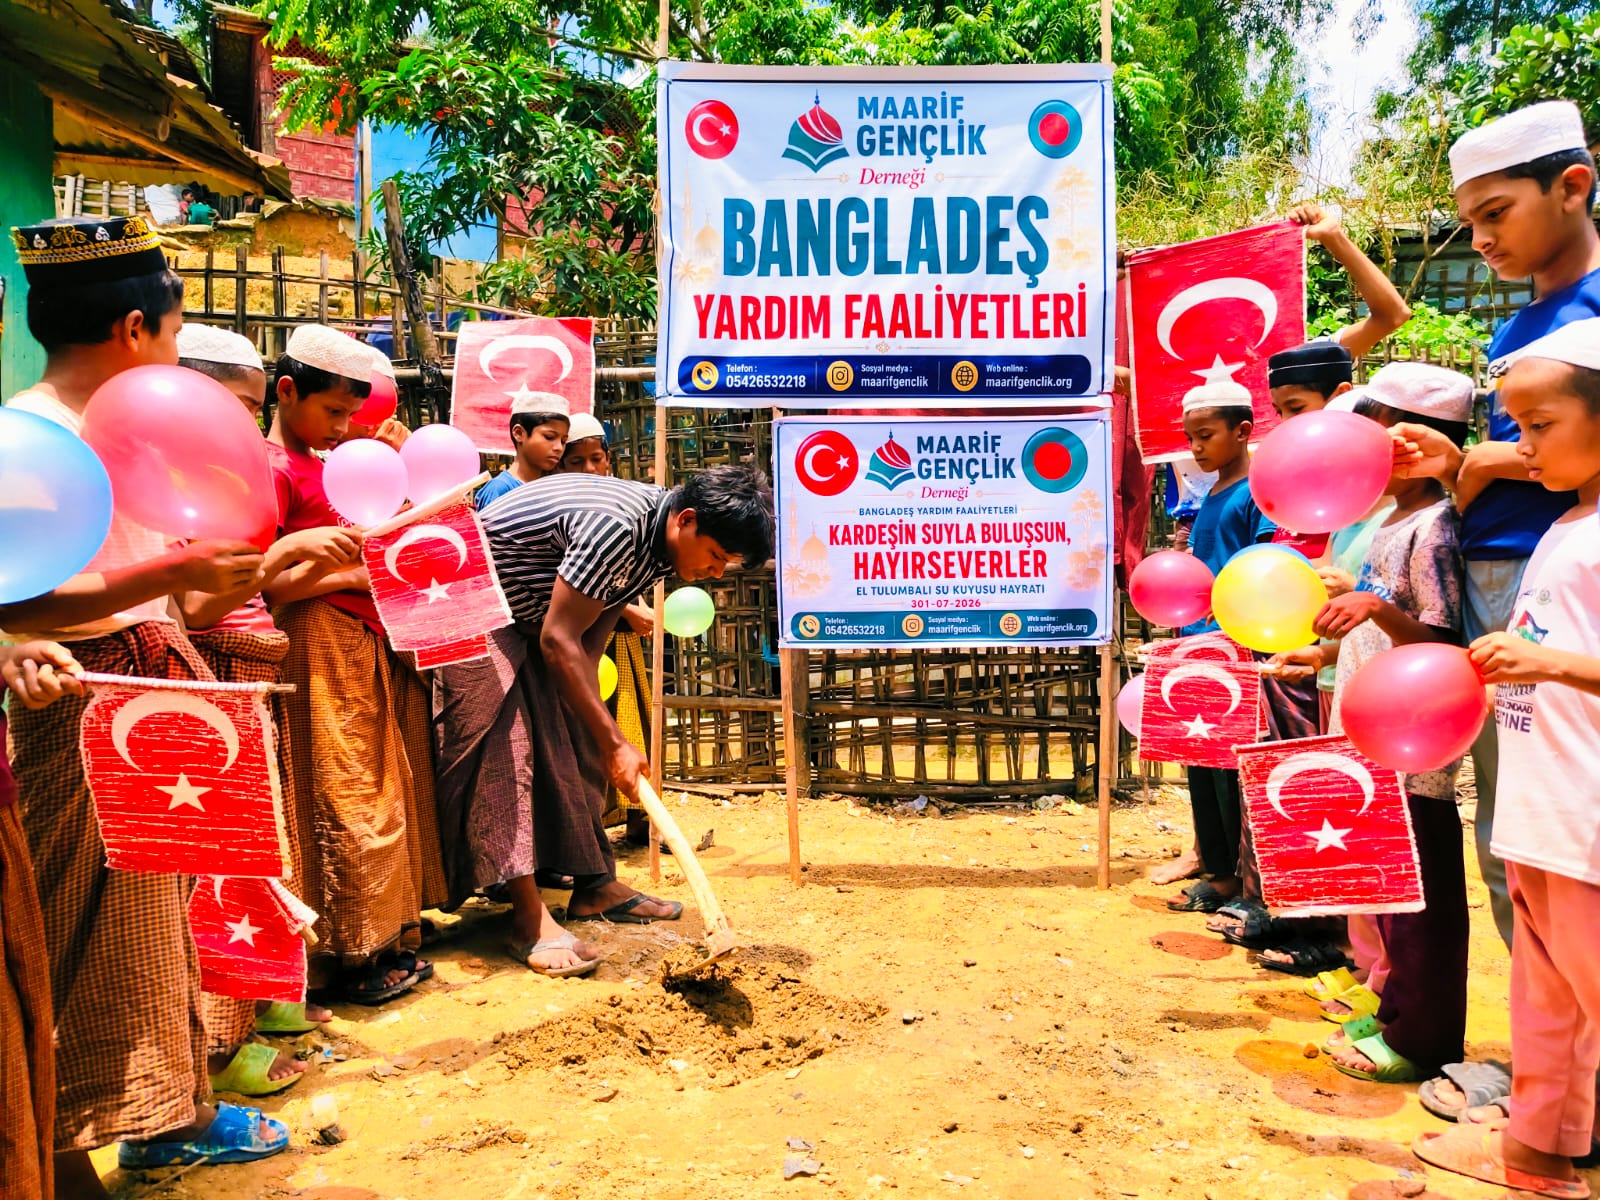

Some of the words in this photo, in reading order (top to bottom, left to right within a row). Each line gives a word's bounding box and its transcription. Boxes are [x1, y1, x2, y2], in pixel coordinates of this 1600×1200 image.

[858, 91, 964, 119] MAARİF
[857, 119, 987, 164] GENÇLİK
[859, 167, 926, 190] Derneği
[723, 196, 1049, 288] BANGLADEŞ
[693, 294, 830, 340] YARDIM
[845, 282, 1087, 339] FAALİYETLERİ
[726, 364, 753, 373] Telefon
[861, 364, 884, 374] Sosyal
[886, 365, 909, 374] medya
[726, 375, 806, 388] 05426532218
[861, 376, 928, 389] maarifgenclik
[986, 376, 1072, 388] maarifgenclik.org
[917, 431, 1001, 454] MAARİF
[917, 453, 1016, 485] GENÇLİK
[921, 486, 969, 501] Derneği
[859, 507, 914, 517] BANGLADEŞ
[917, 507, 953, 515] YARDIM
[956, 504, 1018, 515] FAALİYETLERİ
[829, 519, 916, 550] KARDEŞİN
[921, 523, 976, 544] SUYLA
[981, 521, 1071, 548] BULUŞSUN,
[854, 550, 1048, 580] HAYIRSEVERLER
[856, 587, 868, 596] EL
[871, 586, 932, 595] TULUMBALI
[936, 586, 949, 595] SU
[953, 585, 996, 595] KUYUSU
[1000, 584, 1045, 594] HAYRATI
[911, 599, 981, 608] 301-07-2026
[825, 625, 886, 636] 05426532218
[928, 624, 982, 635] maarifgenclik
[1027, 622, 1088, 634] maarifgenclik.org
